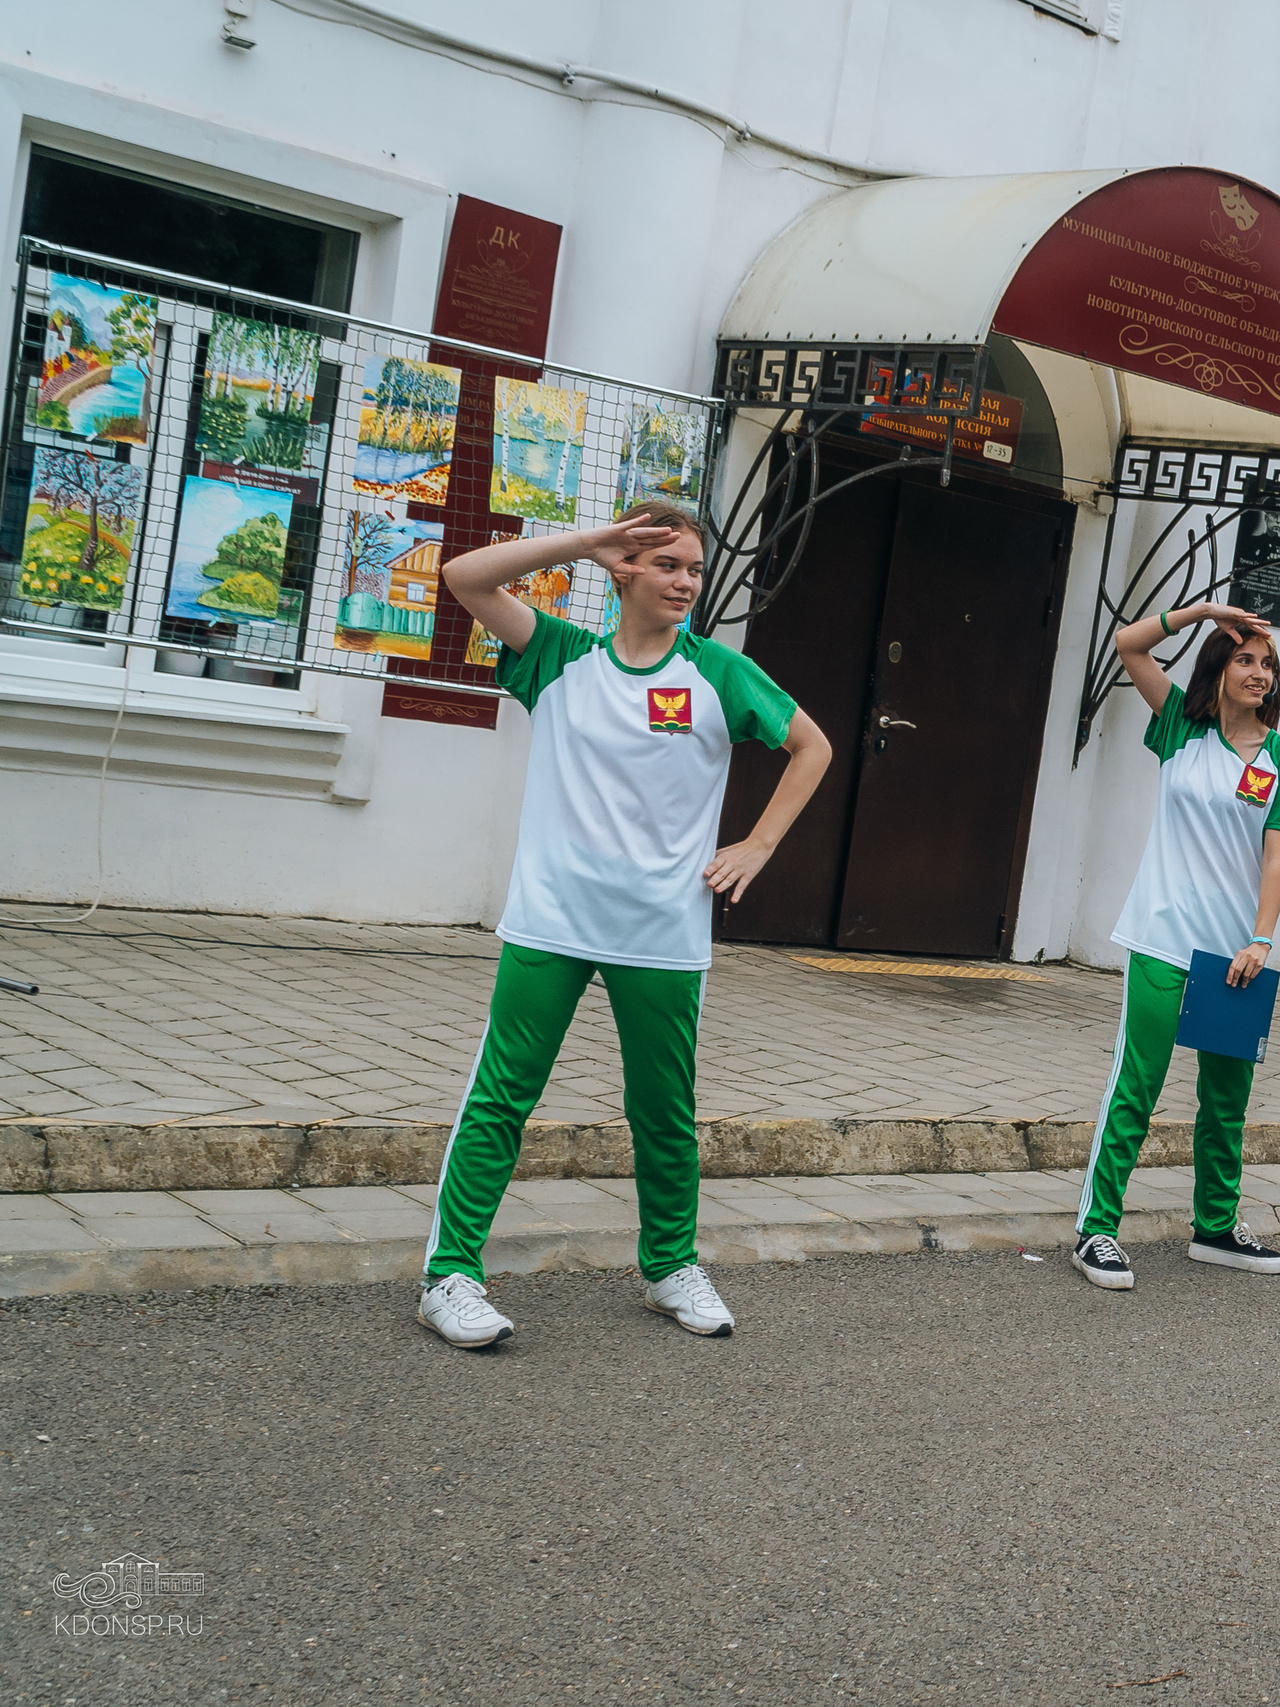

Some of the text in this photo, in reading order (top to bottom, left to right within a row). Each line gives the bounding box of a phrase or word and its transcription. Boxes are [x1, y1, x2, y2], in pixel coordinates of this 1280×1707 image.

[489, 226, 521, 250] ДК
[1062, 216, 1172, 264] МУНИЦИПАЛЬНОЕ
[1173, 254, 1242, 289] БЮДЖЕТНОЕ
[1109, 275, 1238, 329] КУЛЬТУРНО-ДОСУГОВОЕ
[1086, 293, 1203, 341] НОВОТИТАРОВСКОГО
[1204, 332, 1265, 361] СЕЛЬСКОГО
[869, 415, 938, 441] ИЗБИРАТЕЛЬНОГО
[939, 433, 971, 450] УЧСТКА
[911, 395, 1010, 428] ИЗРАТЬНАЯ
